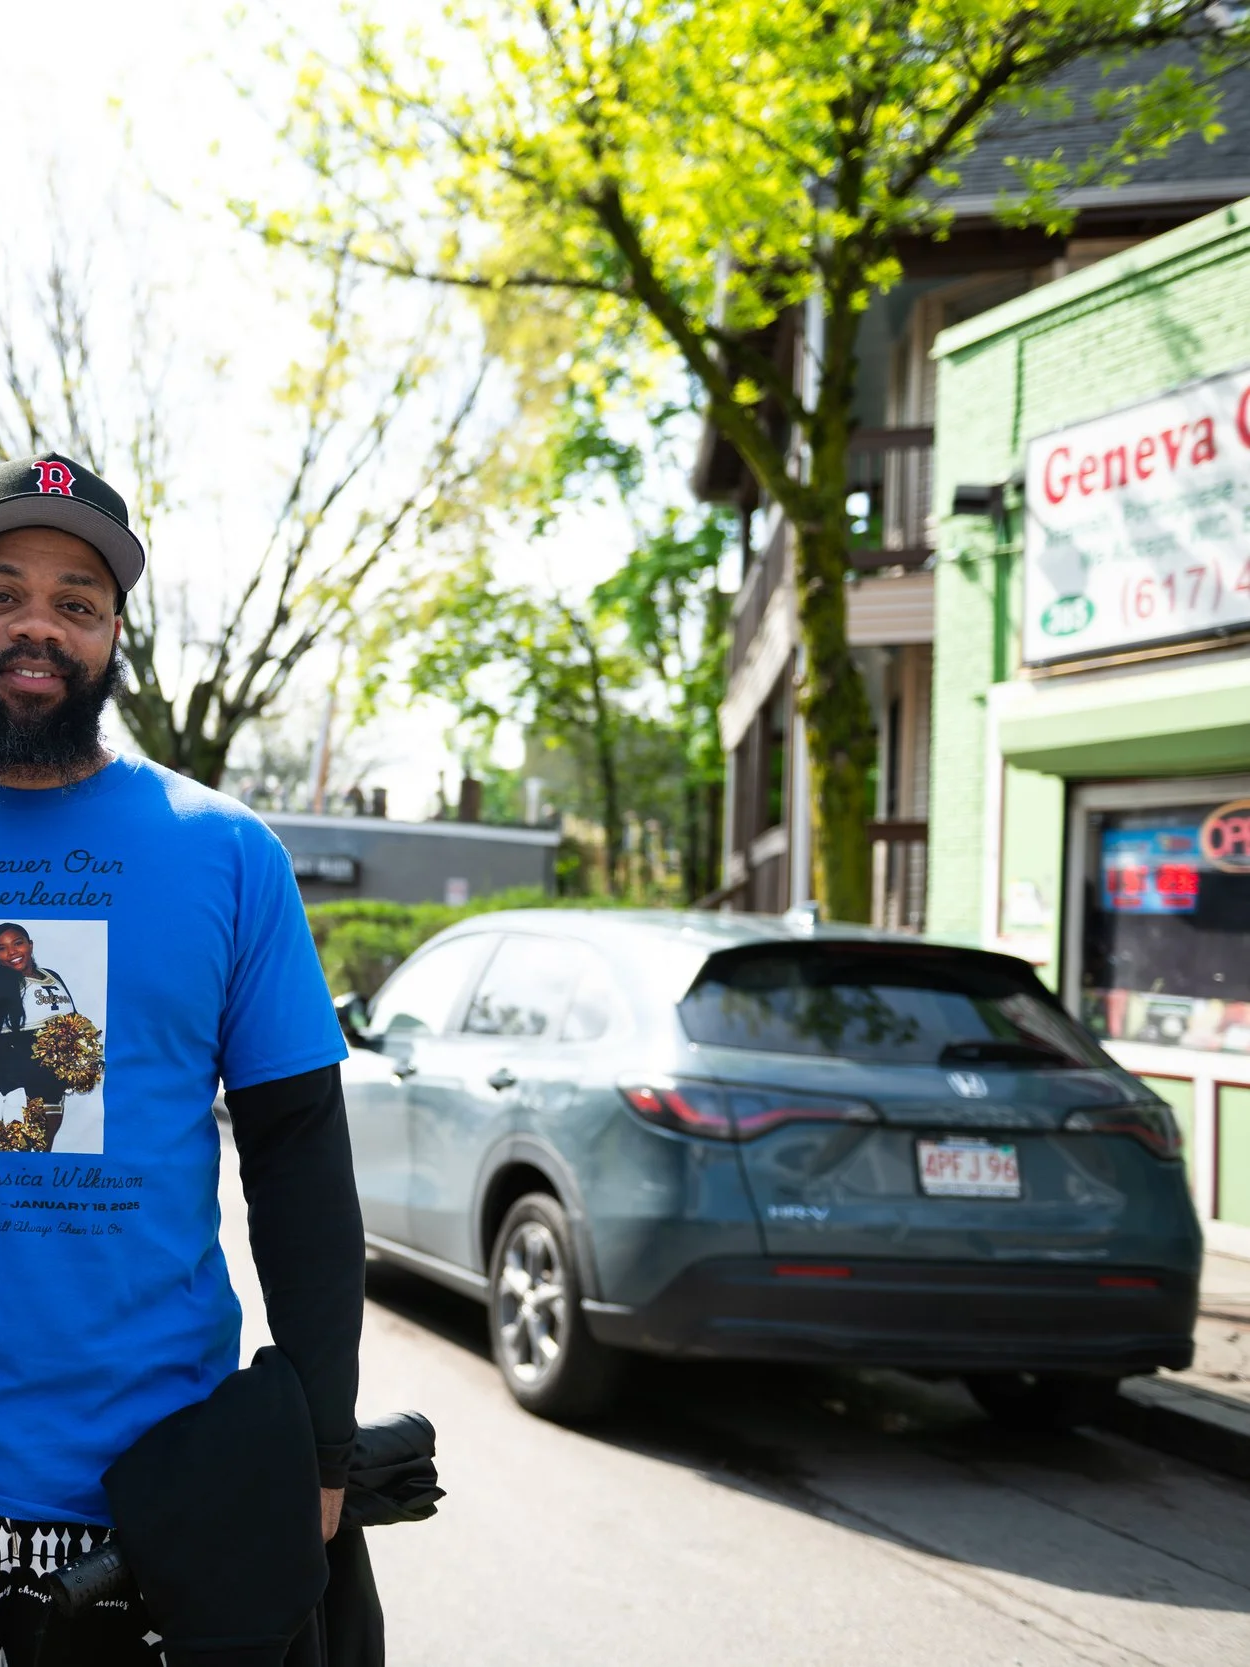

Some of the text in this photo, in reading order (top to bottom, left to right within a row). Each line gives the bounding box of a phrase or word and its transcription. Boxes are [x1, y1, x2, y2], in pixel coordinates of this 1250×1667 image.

[1043, 415, 1217, 504] Geneva
[1120, 560, 1223, 627] (617)
[63, 849, 123, 874] Our
[52, 1166, 143, 1189] Wilkinson
[10, 1200, 88, 1211] JANUARY
[110, 1201, 140, 1211] 2025
[13, 1221, 53, 1237] Always
[107, 1223, 123, 1235] On
